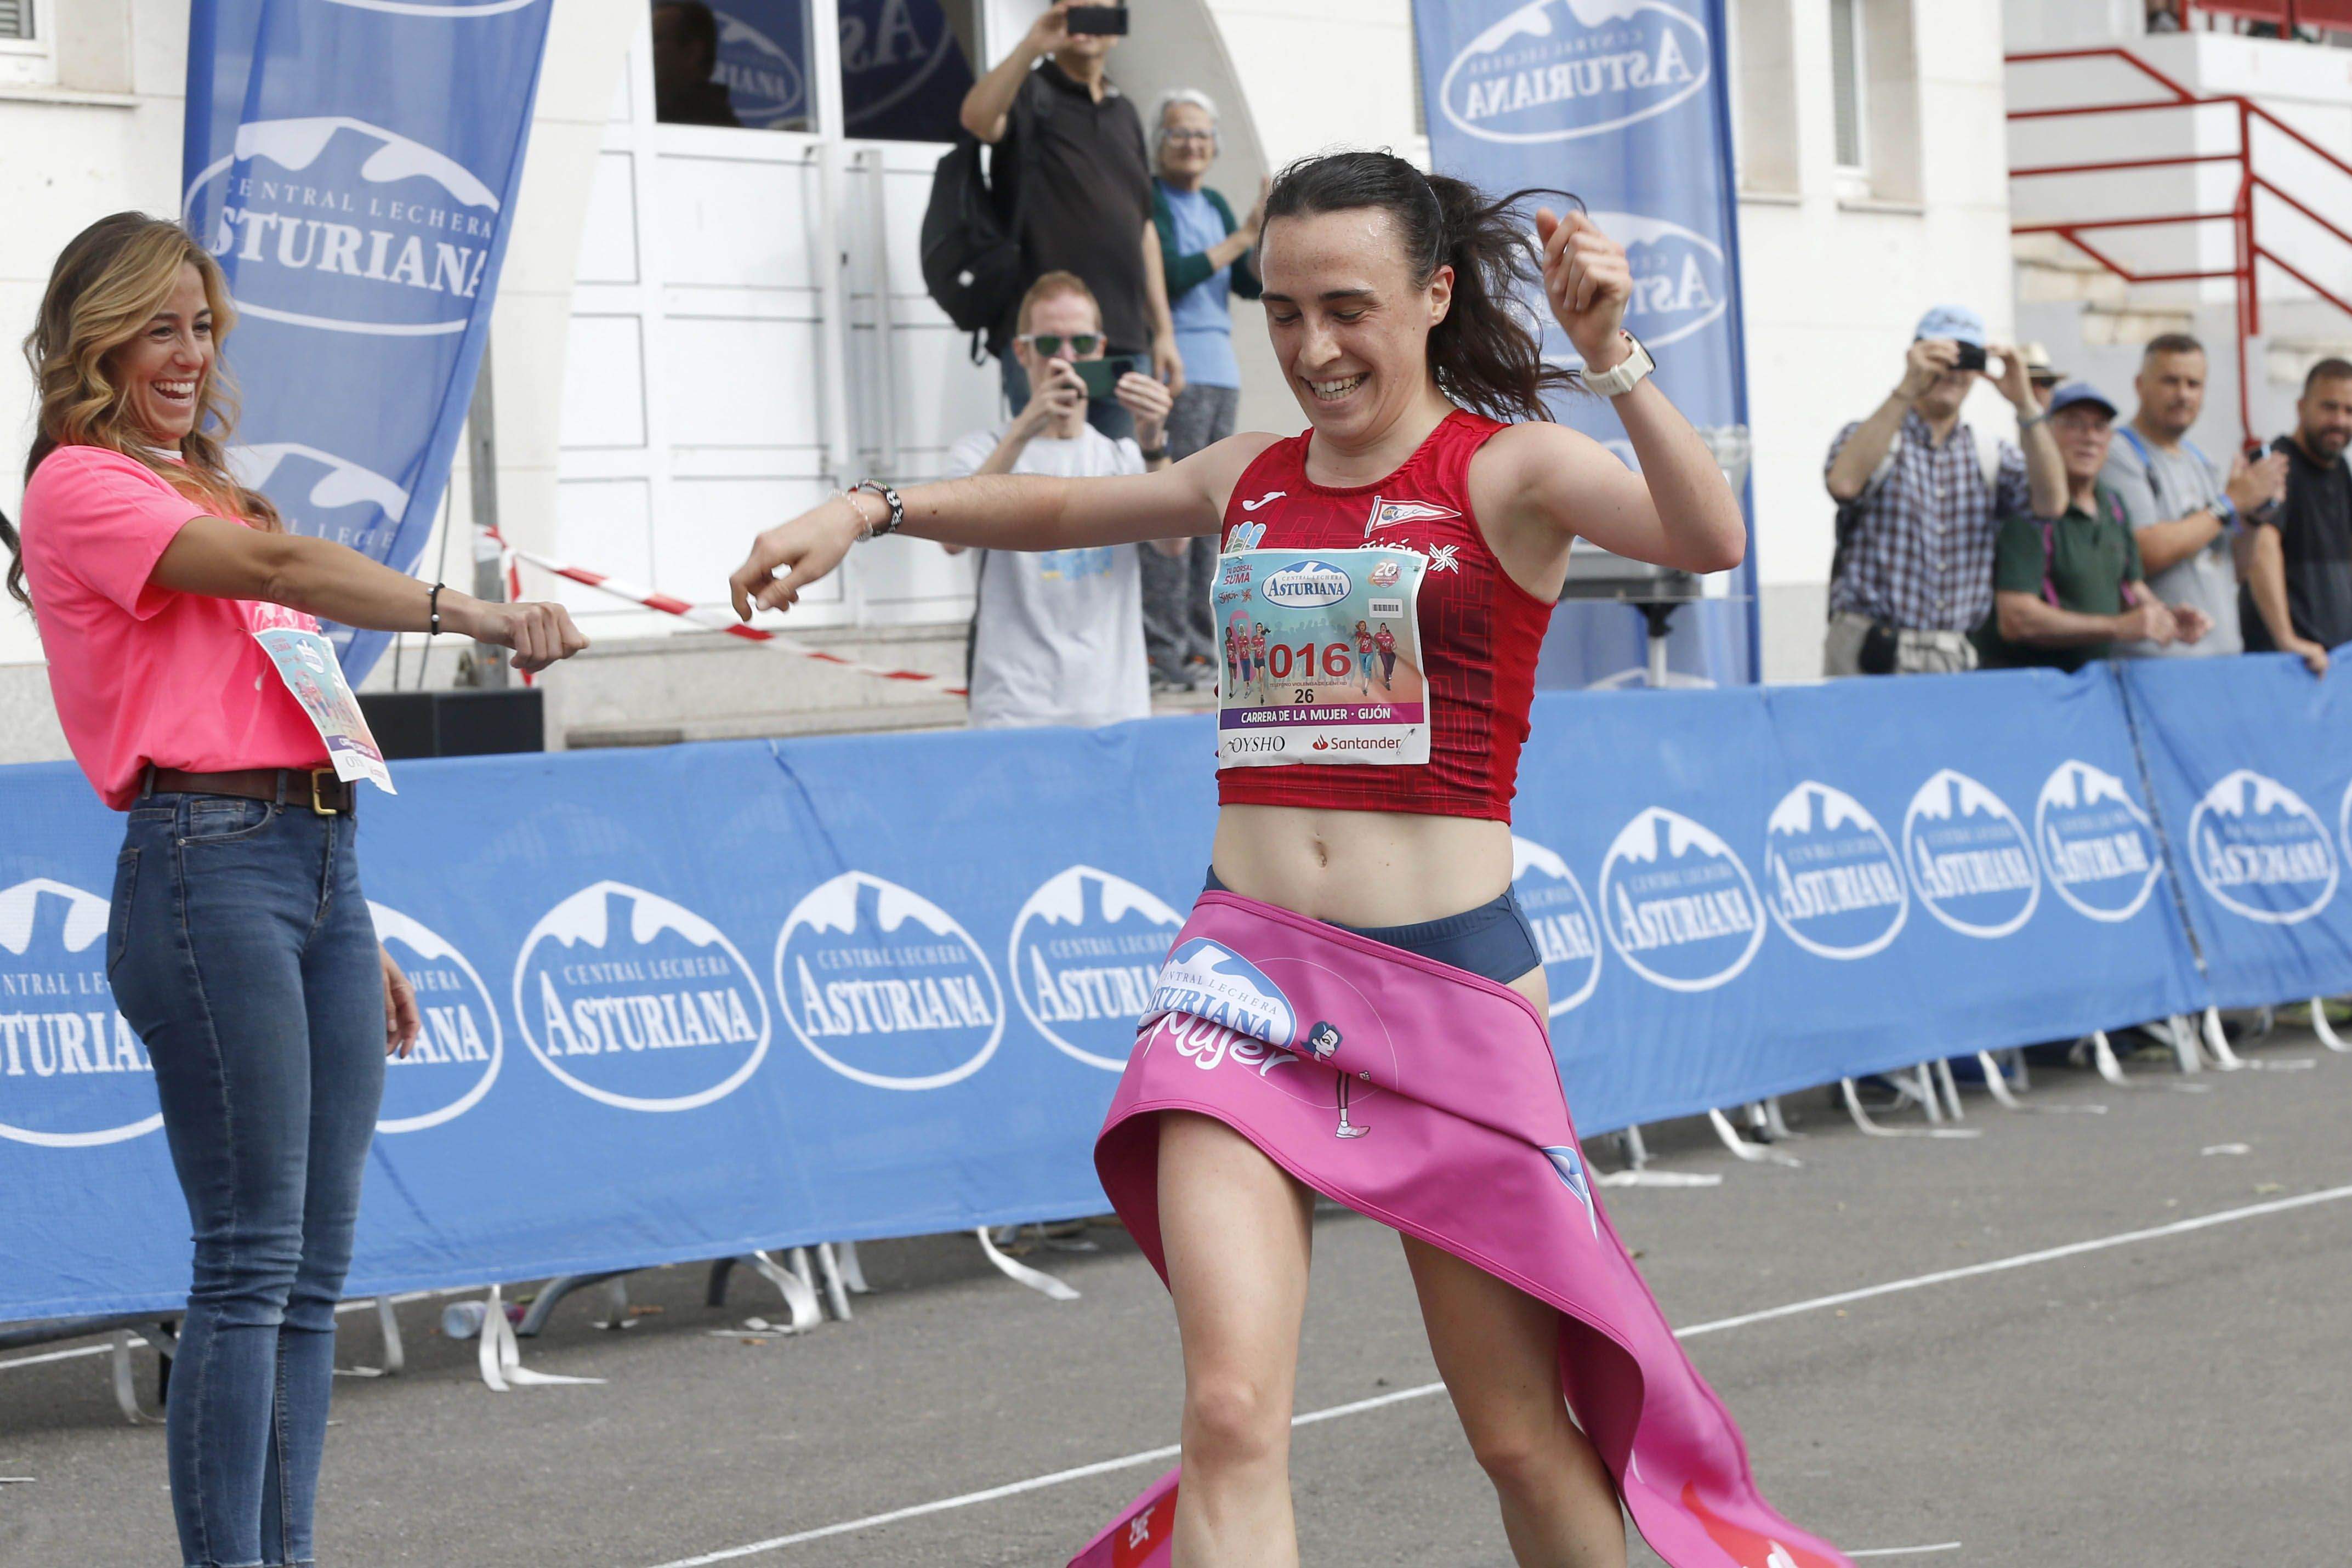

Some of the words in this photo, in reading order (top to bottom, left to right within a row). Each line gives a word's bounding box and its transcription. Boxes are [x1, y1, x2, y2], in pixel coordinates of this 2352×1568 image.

[370, 198, 492, 238] LECHERA
[1223, 573, 1250, 585] SUMA
[1233, 565, 1253, 573] DORSAL
[1268, 578, 1345, 596] ASTURIANA
[1269, 643, 1351, 679] 016
[1241, 712, 1277, 723] CARRERA
[1278, 709, 1290, 721] DE
[1293, 709, 1306, 721] LA
[1310, 707, 1348, 720] MUJER
[1358, 704, 1391, 720] GIJÓN
[1294, 689, 1314, 703] 26
[1232, 735, 1286, 753] OYSHO
[1331, 736, 1401, 751] Santander
[1615, 880, 1754, 952] ASTURIANA
[2, 972, 70, 996] NTRAL
[564, 961, 646, 985] CENTRAL
[648, 956, 731, 980] LECHERA
[796, 954, 993, 1037] ASTURIANA
[1163, 971, 1203, 985] NTRAL
[1208, 979, 1278, 1015] LECHERA
[540, 970, 758, 1056] ASTURIANA
[1145, 986, 1272, 1042] STURIANA
[0, 1010, 155, 1077] TURIA
[1142, 1012, 1299, 1077] Mujer
